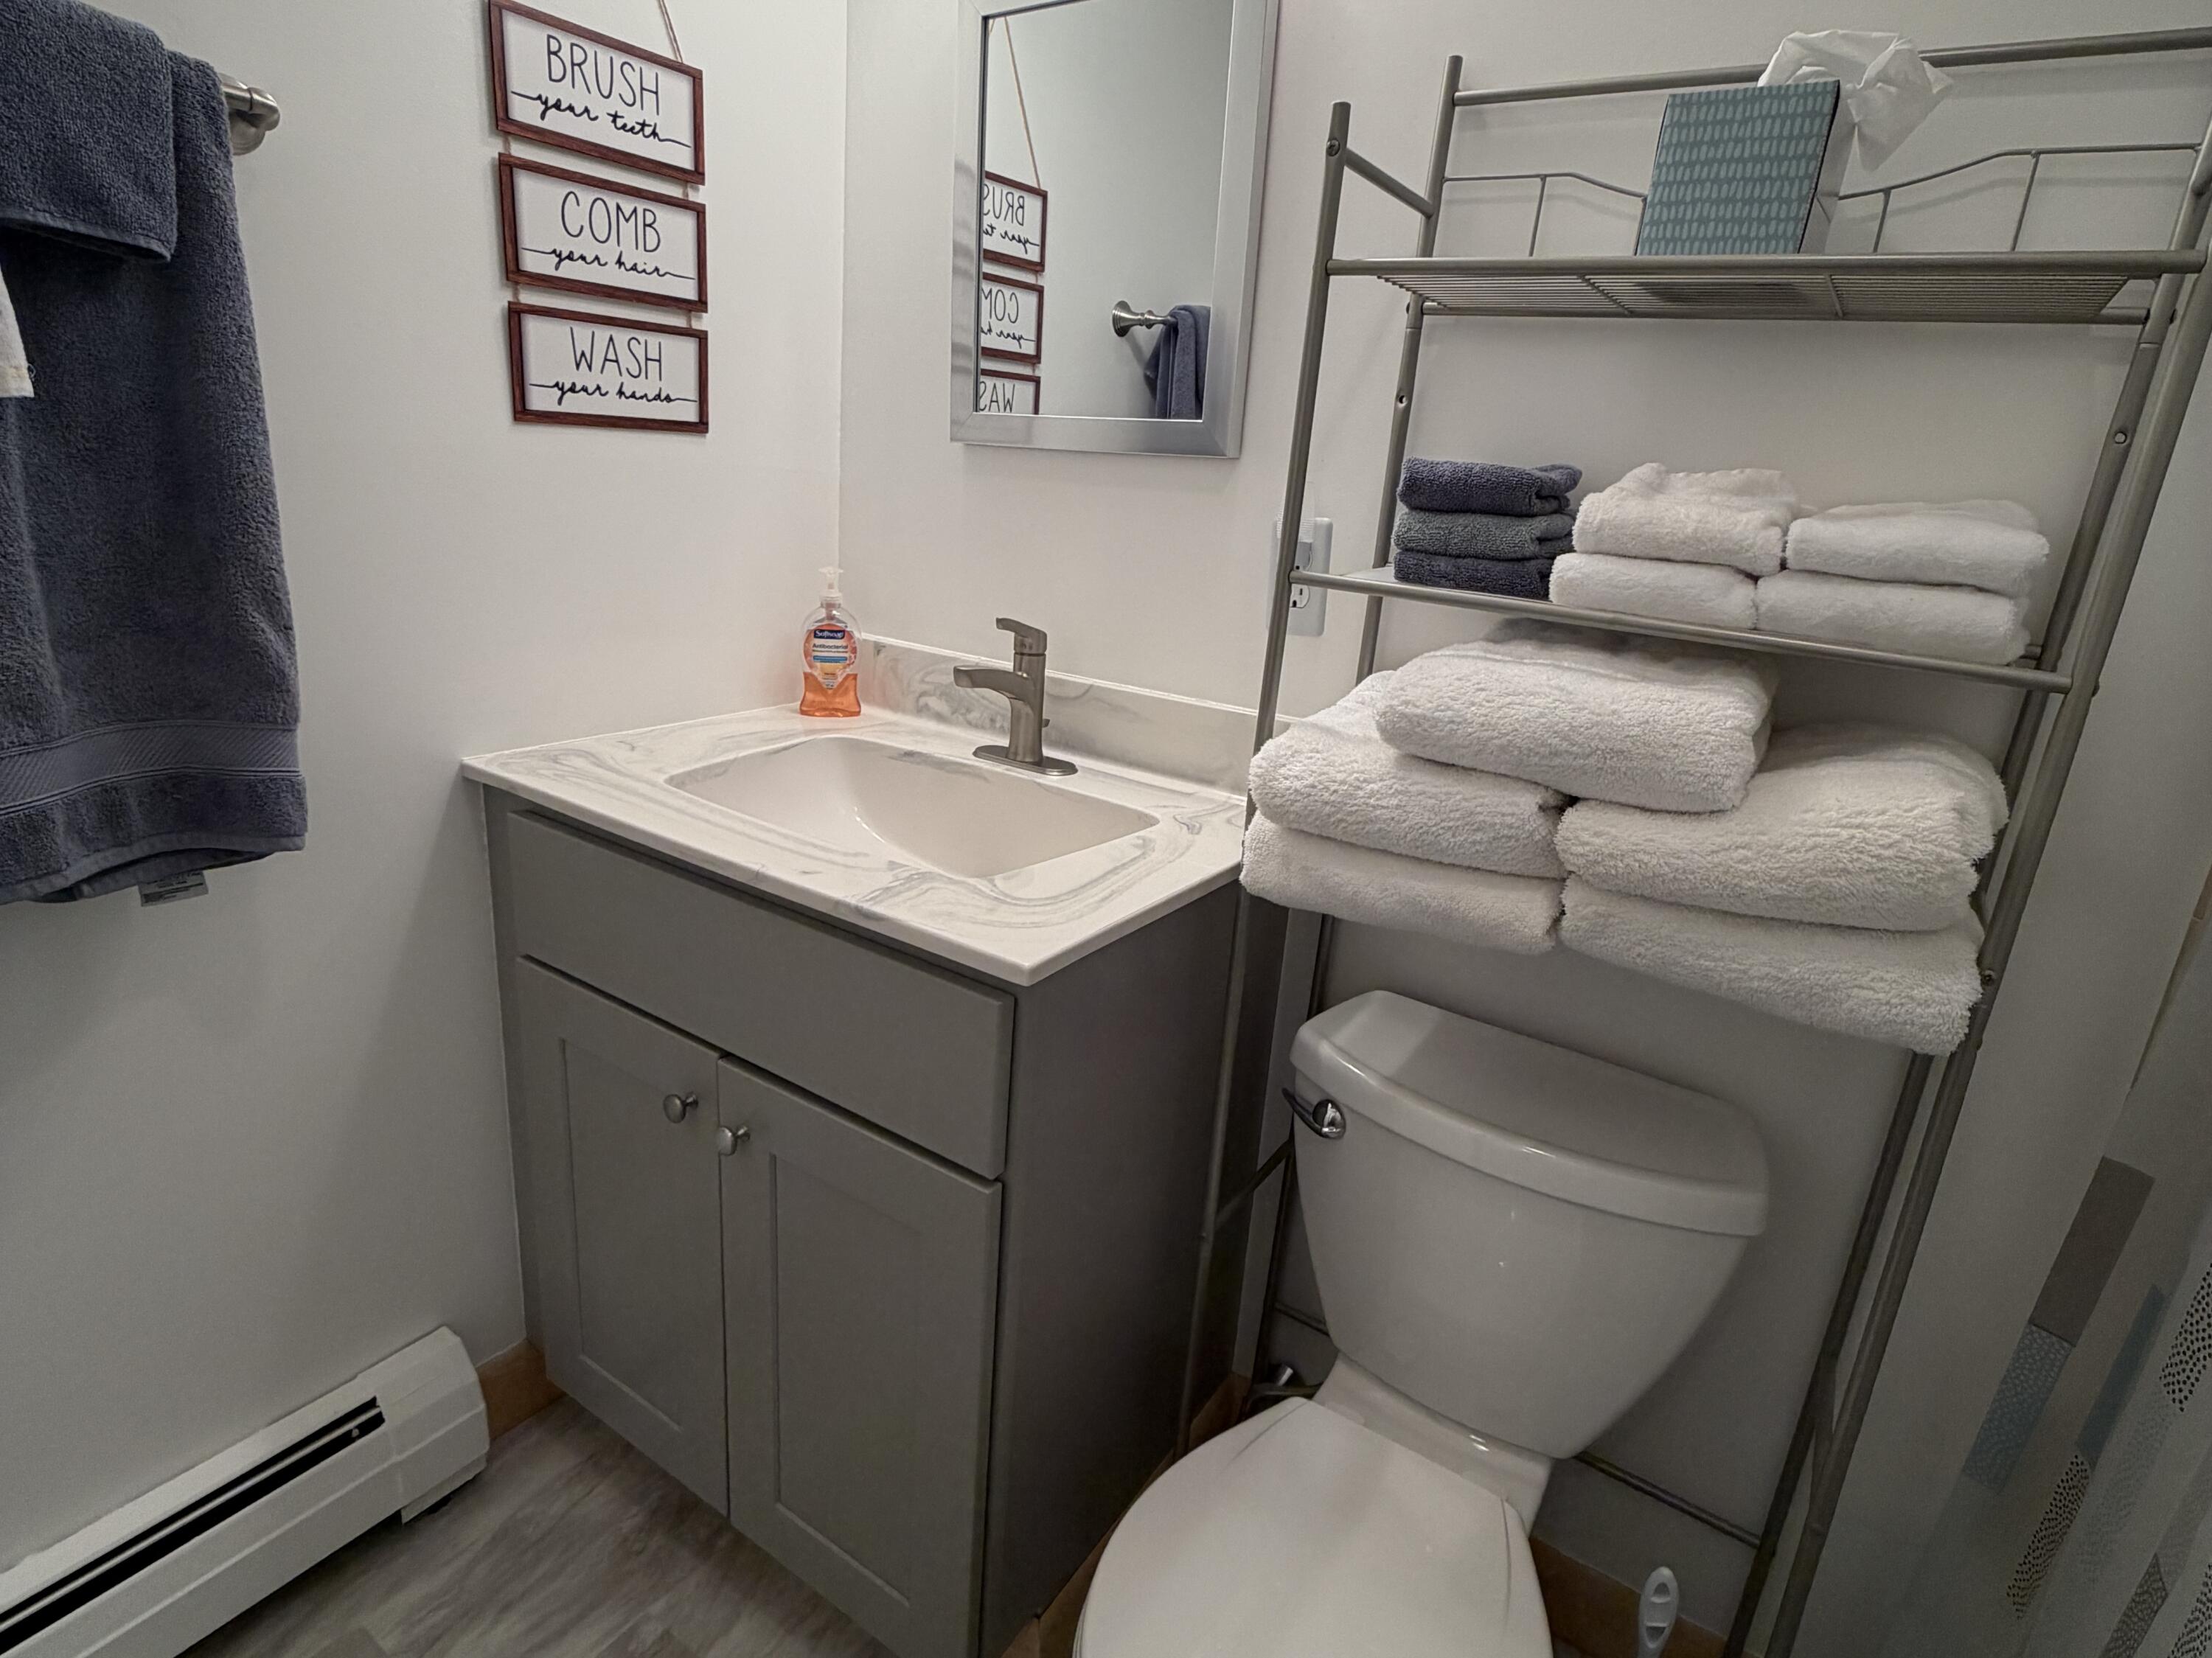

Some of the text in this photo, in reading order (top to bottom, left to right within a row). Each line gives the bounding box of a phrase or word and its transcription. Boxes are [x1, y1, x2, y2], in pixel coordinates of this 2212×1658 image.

[546, 34, 660, 116] BRUSH
[512, 91, 692, 148] your teeth
[561, 190, 661, 253] COMB
[521, 247, 695, 280] your hair
[570, 326, 663, 382] WASH
[529, 379, 698, 406] your hands
[815, 630, 844, 638] Softsoap
